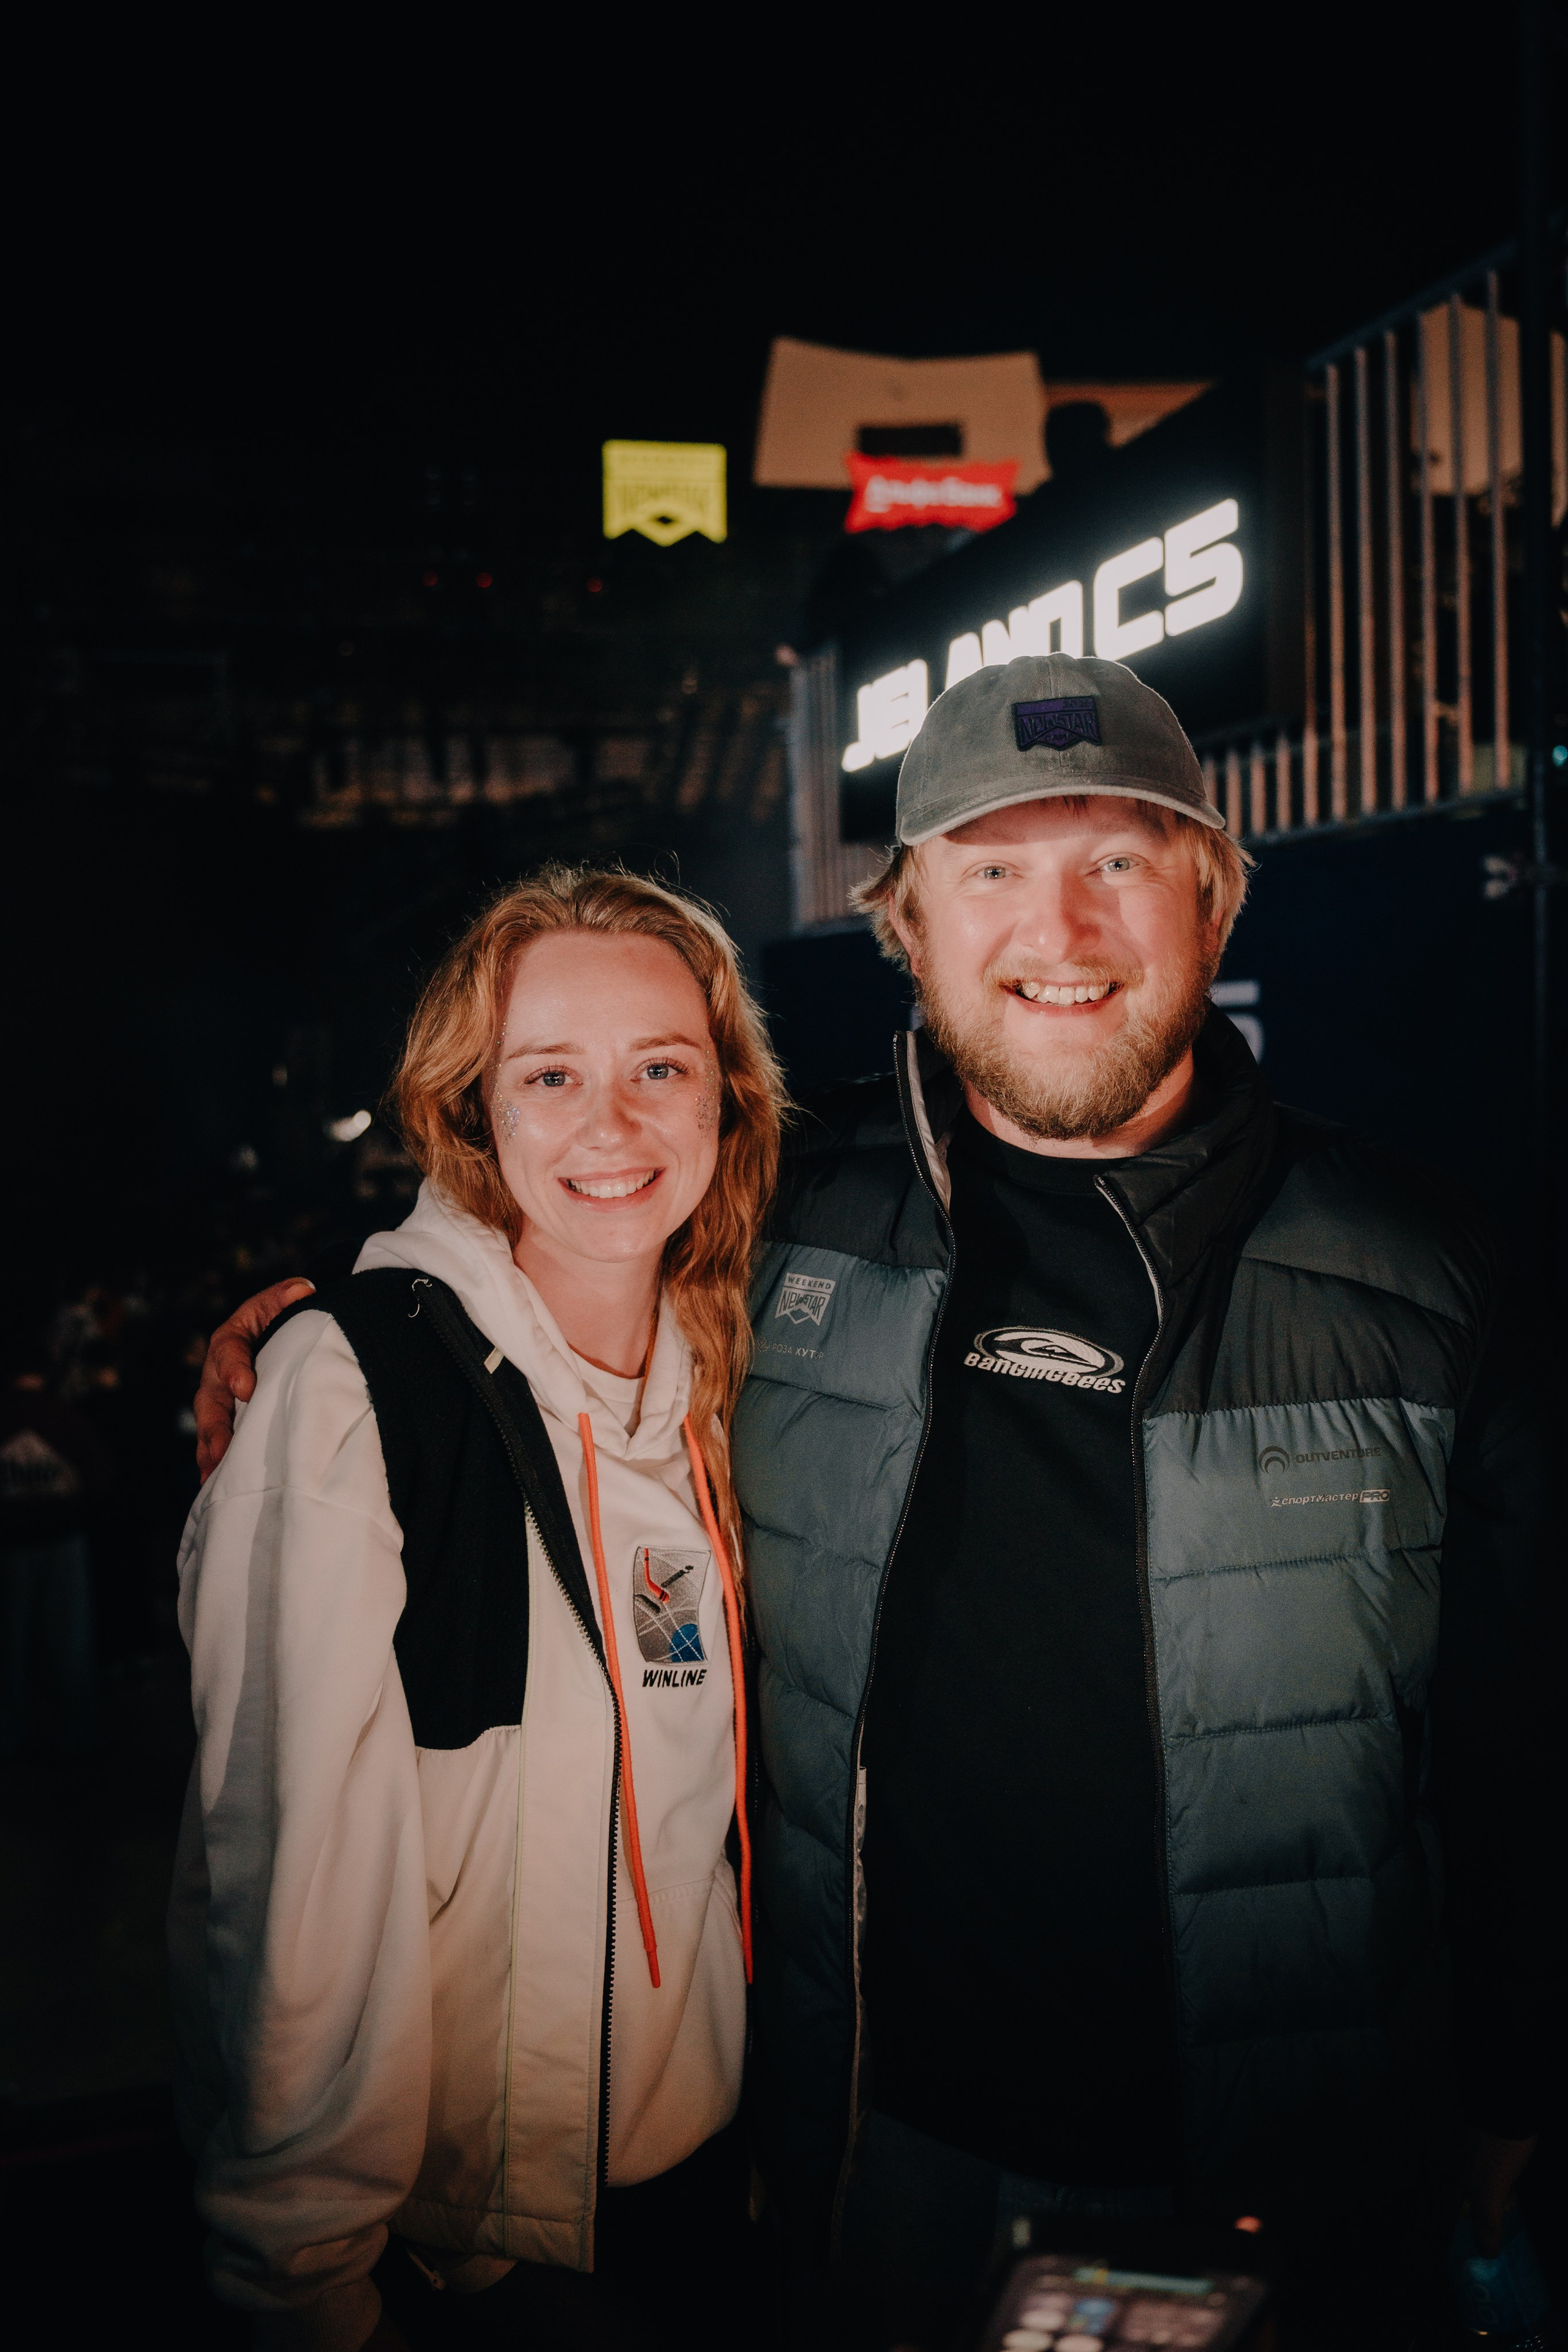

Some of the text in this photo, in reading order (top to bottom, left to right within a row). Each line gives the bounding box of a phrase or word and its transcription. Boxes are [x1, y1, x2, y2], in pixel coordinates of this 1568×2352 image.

[788, 1277, 831, 1289] WEEKEND
[778, 1291, 826, 1319] NEWSTAR
[772, 1343, 824, 1360] РОЗА ХУТОР
[1295, 1446, 1382, 1464] OUTVENTURE
[1362, 1490, 1390, 1502] PRO
[643, 1670, 707, 1687] WINLINE
